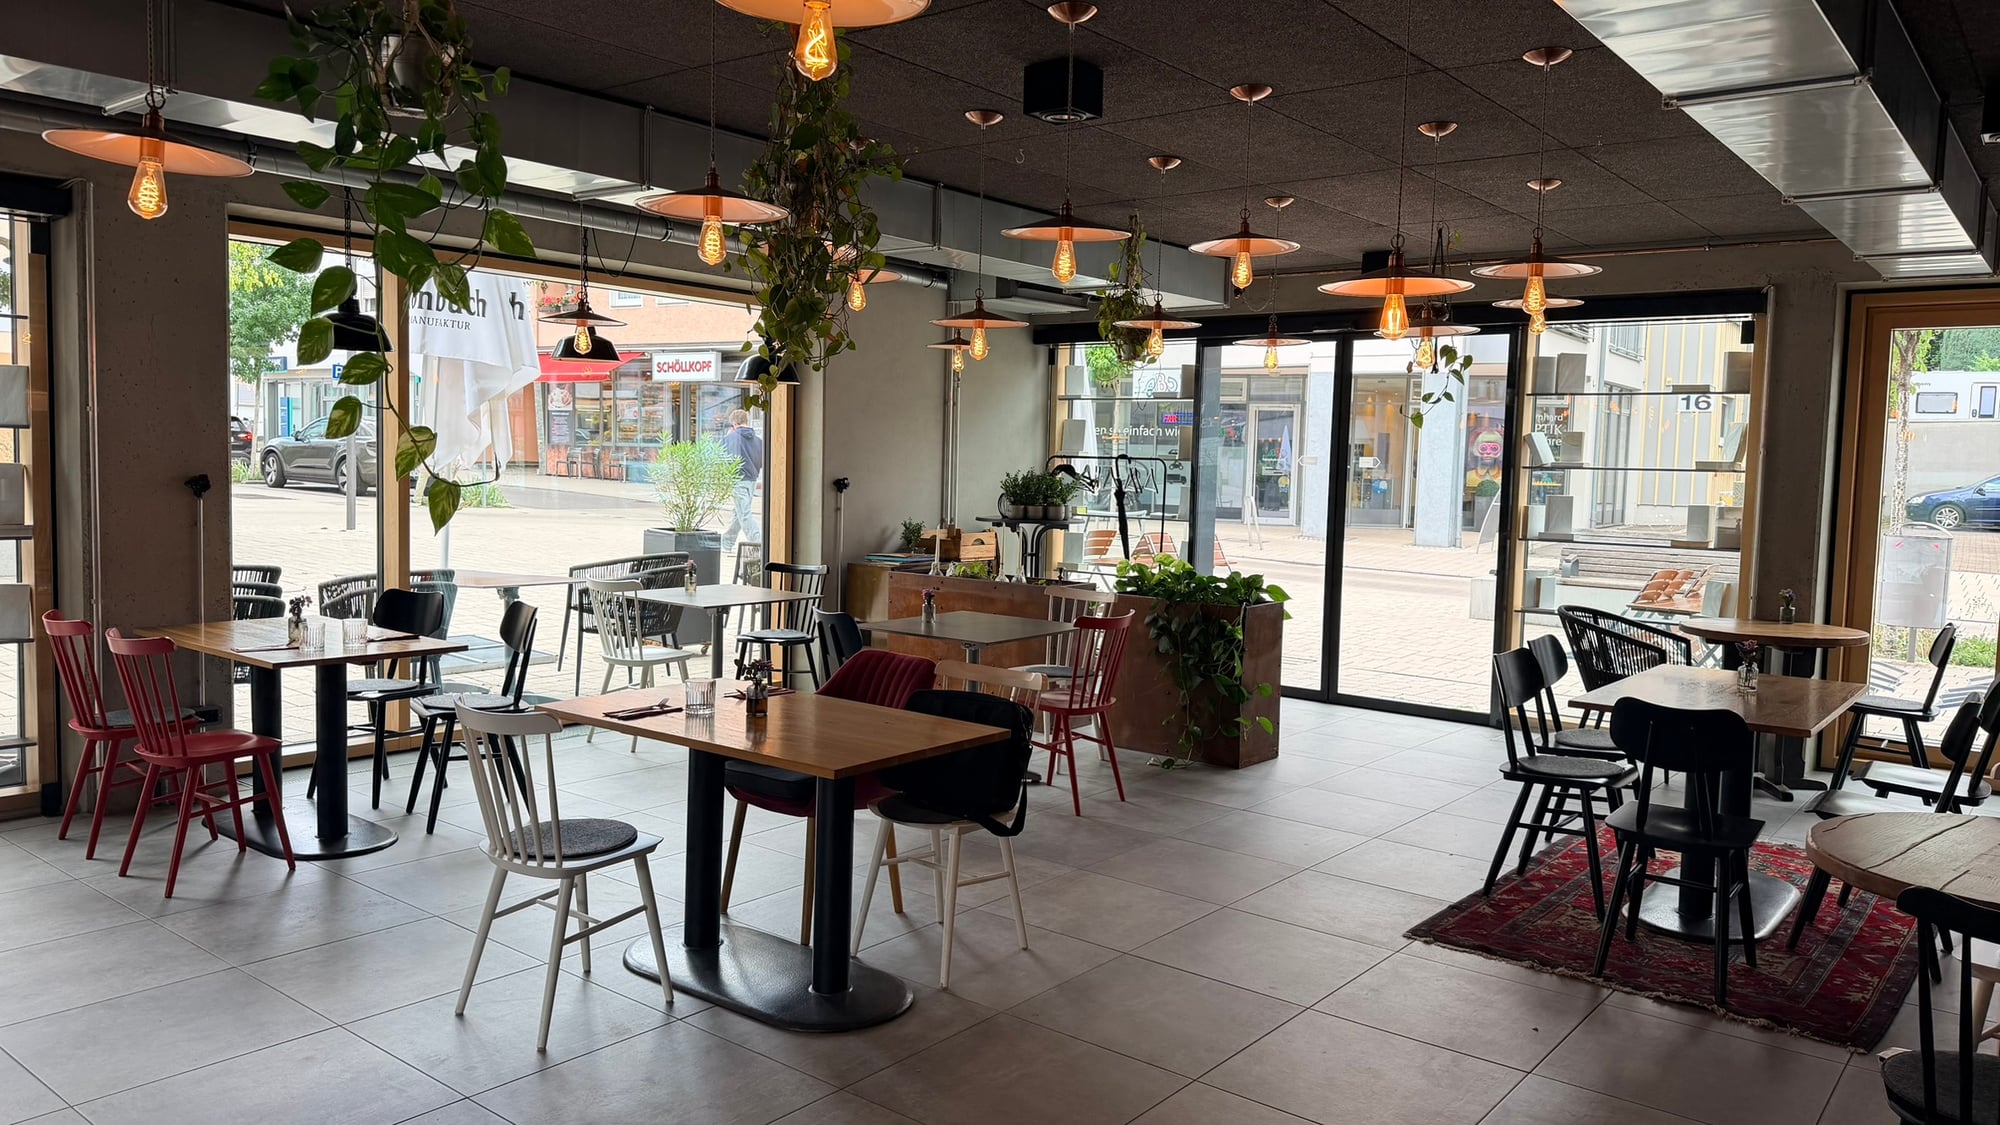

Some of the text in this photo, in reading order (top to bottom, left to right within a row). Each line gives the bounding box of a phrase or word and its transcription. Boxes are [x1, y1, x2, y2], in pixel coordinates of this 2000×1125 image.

[656, 359, 713, 373] SCHÖLLKOPF
[1681, 394, 1712, 411] 16
[1123, 424, 1163, 437] einfach
